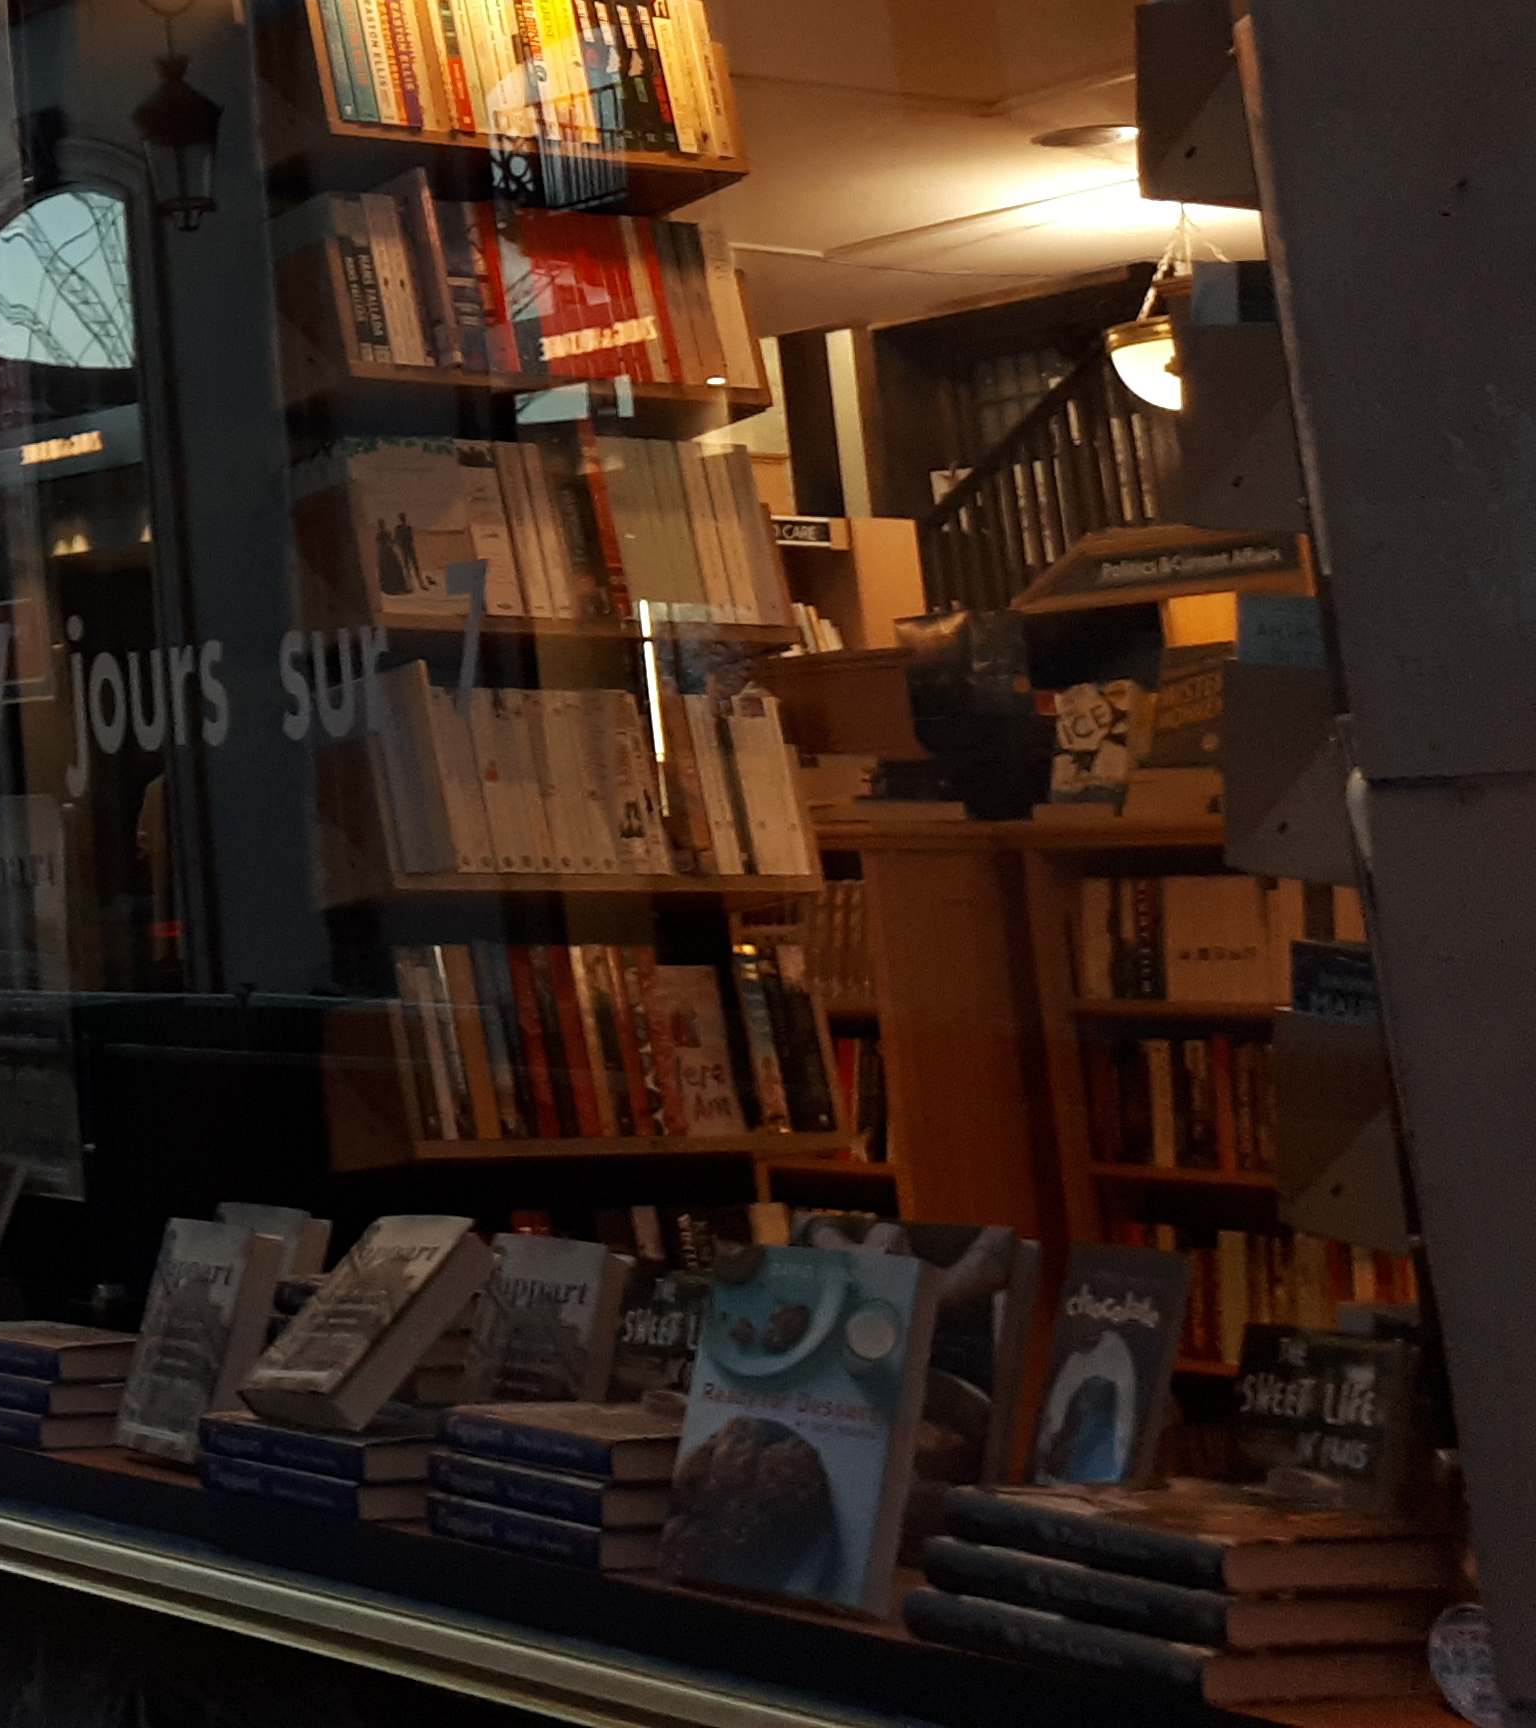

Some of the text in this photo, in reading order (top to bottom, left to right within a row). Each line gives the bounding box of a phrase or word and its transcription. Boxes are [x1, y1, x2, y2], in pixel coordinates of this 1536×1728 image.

[373, 51, 388, 88] ELLIS
[64, 614, 227, 798] jours
[279, 624, 390, 741] sur
[445, 558, 488, 717] 7
